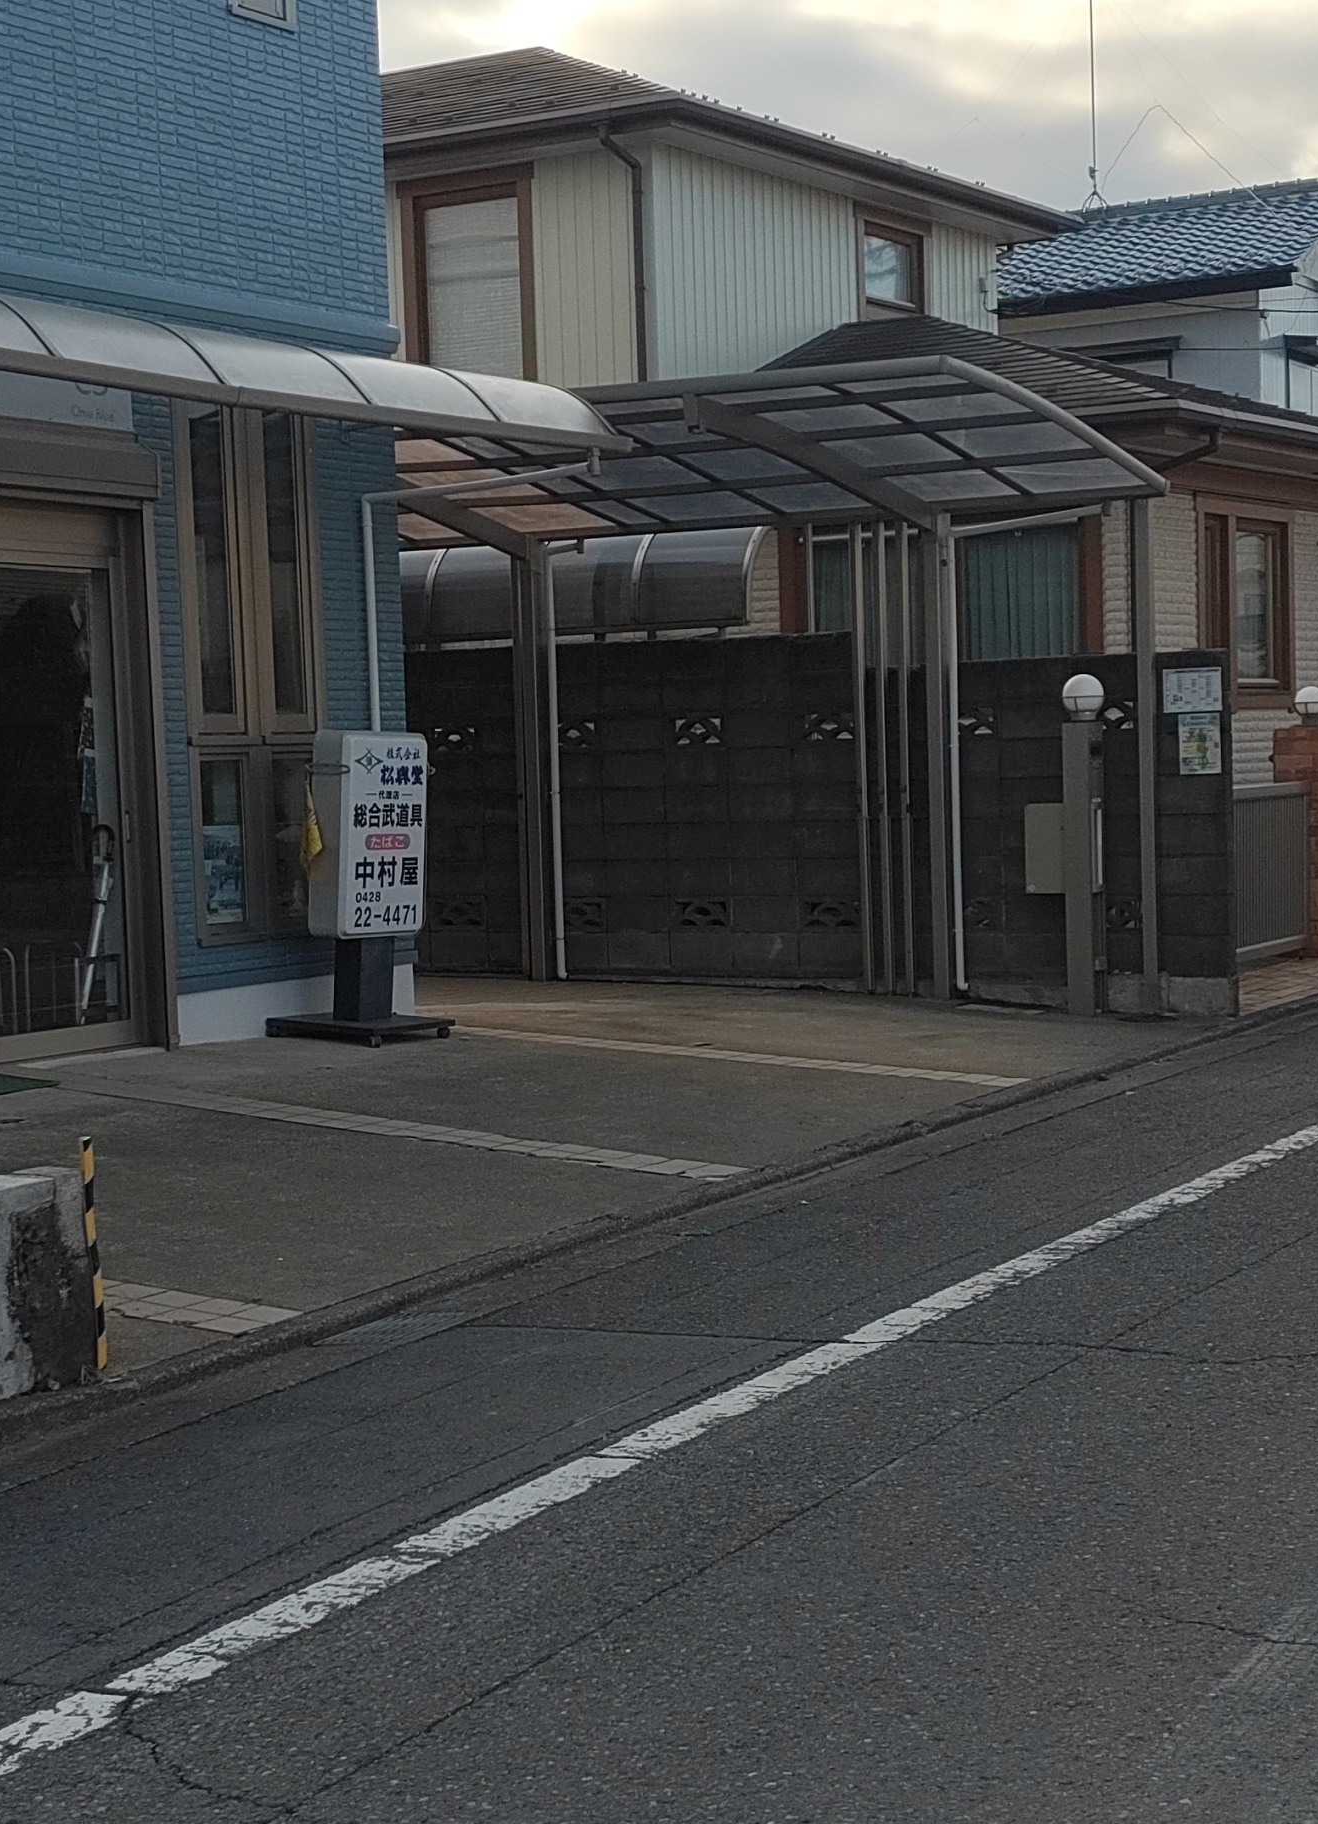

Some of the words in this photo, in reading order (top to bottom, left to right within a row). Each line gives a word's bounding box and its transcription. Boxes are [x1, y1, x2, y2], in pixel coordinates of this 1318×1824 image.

[386, 746, 421, 761] 株式会社
[378, 790, 400, 799] 代理店
[353, 802, 423, 829] 総合武道具
[370, 835, 405, 848] たばこ
[354, 855, 419, 889] 中村屋
[355, 891, 381, 903] 0428
[354, 904, 417, 928] 22-4471
